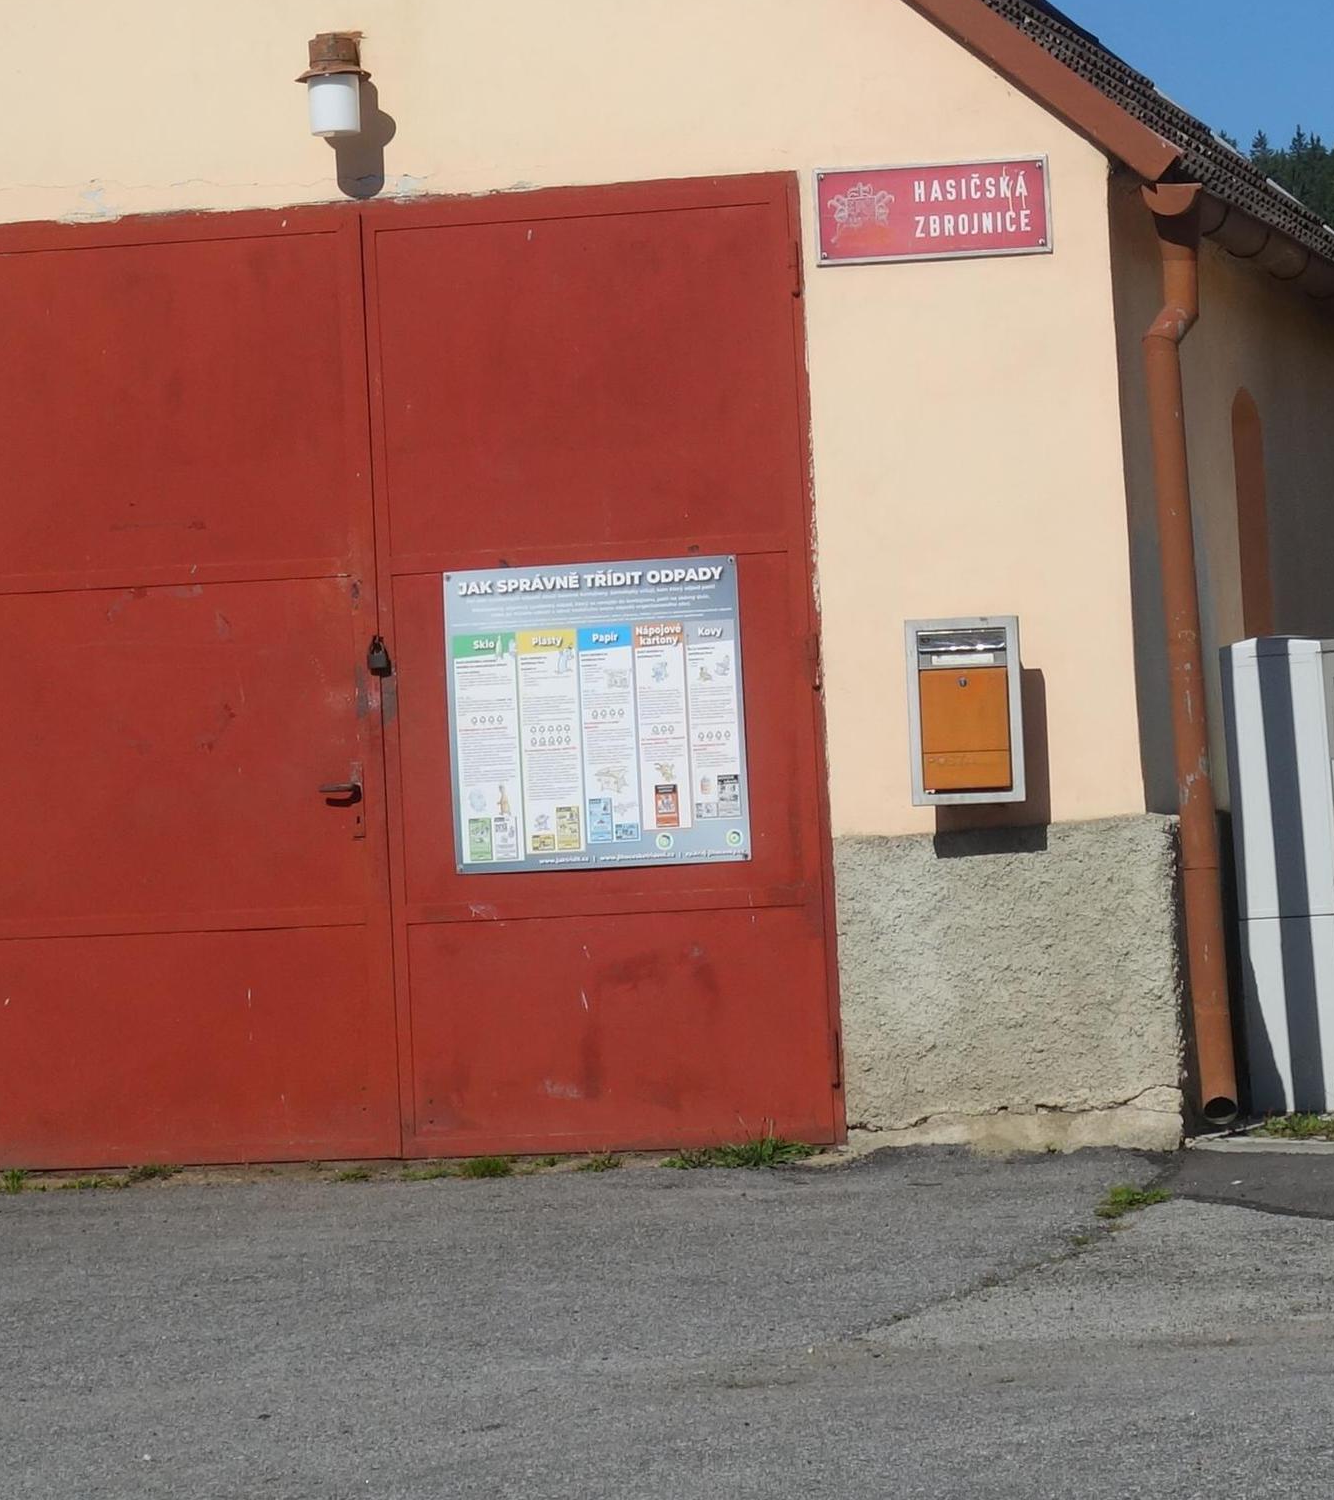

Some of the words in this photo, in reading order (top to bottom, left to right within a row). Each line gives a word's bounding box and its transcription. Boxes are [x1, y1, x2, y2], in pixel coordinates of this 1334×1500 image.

[914, 170, 1028, 202] HASIČSKÁ
[914, 209, 1032, 238] ZBROJNICE
[458, 580, 493, 596] JAK
[496, 571, 580, 594] SPRÁVNĚ
[583, 569, 642, 588] TŘÍDIT
[646, 566, 723, 584] ODPADY
[635, 622, 682, 636] Nápojové
[697, 626, 723, 638] Kovy
[472, 638, 495, 650] Sklo
[531, 635, 563, 647] Plasty
[592, 631, 619, 644] Papír
[639, 634, 679, 646] kartony
